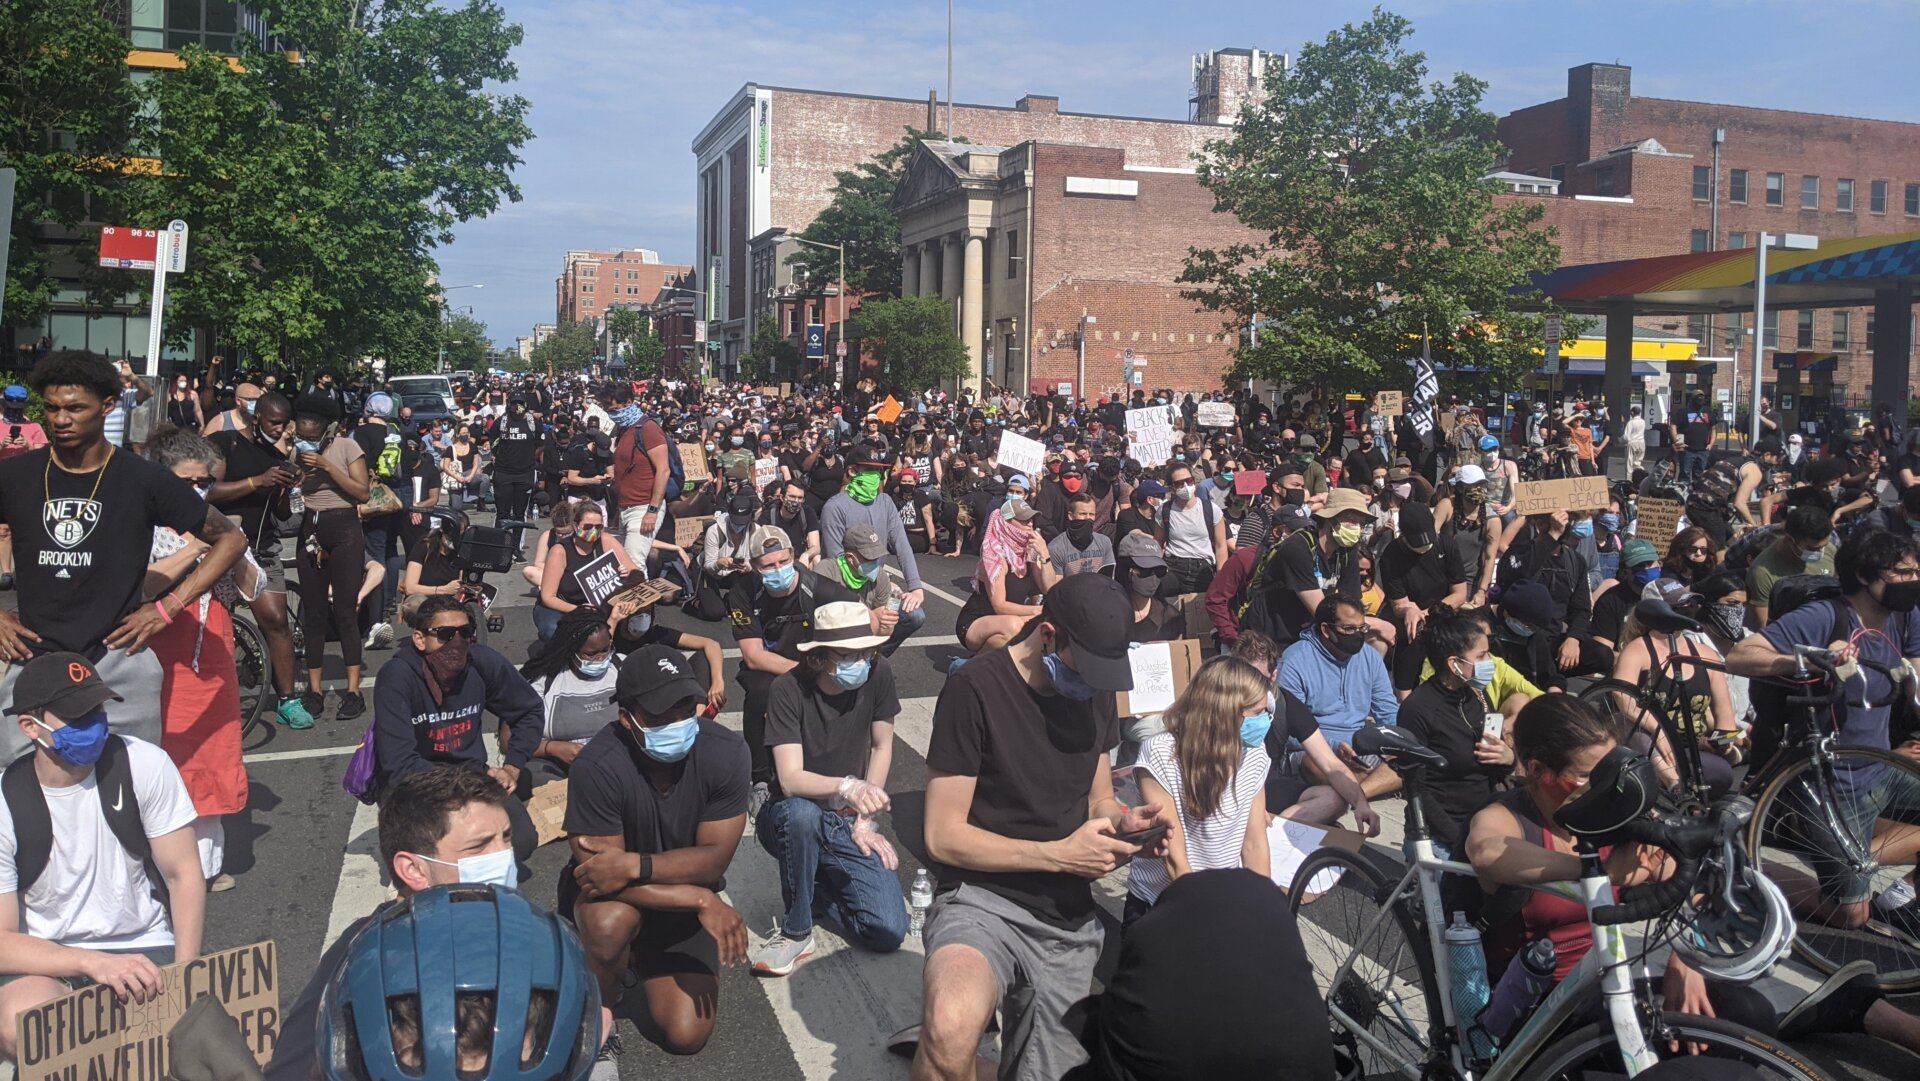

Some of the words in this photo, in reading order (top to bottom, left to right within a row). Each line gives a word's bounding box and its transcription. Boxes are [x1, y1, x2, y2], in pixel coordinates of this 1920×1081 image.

[103, 227, 115, 235] 90
[131, 229, 142, 237] 96
[145, 230, 156, 238] X3
[172, 233, 181, 270] metrobus
[1132, 406, 1167, 429] BLACK
[1137, 426, 1168, 444] LIVES
[1133, 440, 1172, 463] MATTER
[909, 456, 931, 467] LACK
[1525, 482, 1543, 497] NO
[1573, 477, 1592, 492] NO
[1516, 497, 1560, 512] JUSTICE
[1568, 490, 1609, 509] PEACE
[46, 500, 98, 521] NETS
[64, 522, 74, 541] B
[38, 550, 92, 567] BROOKLYN
[585, 562, 617, 590] BLACK
[184, 942, 274, 1011] GIVEN
[131, 989, 183, 1028] BEEN
[139, 1022, 163, 1040] AN
